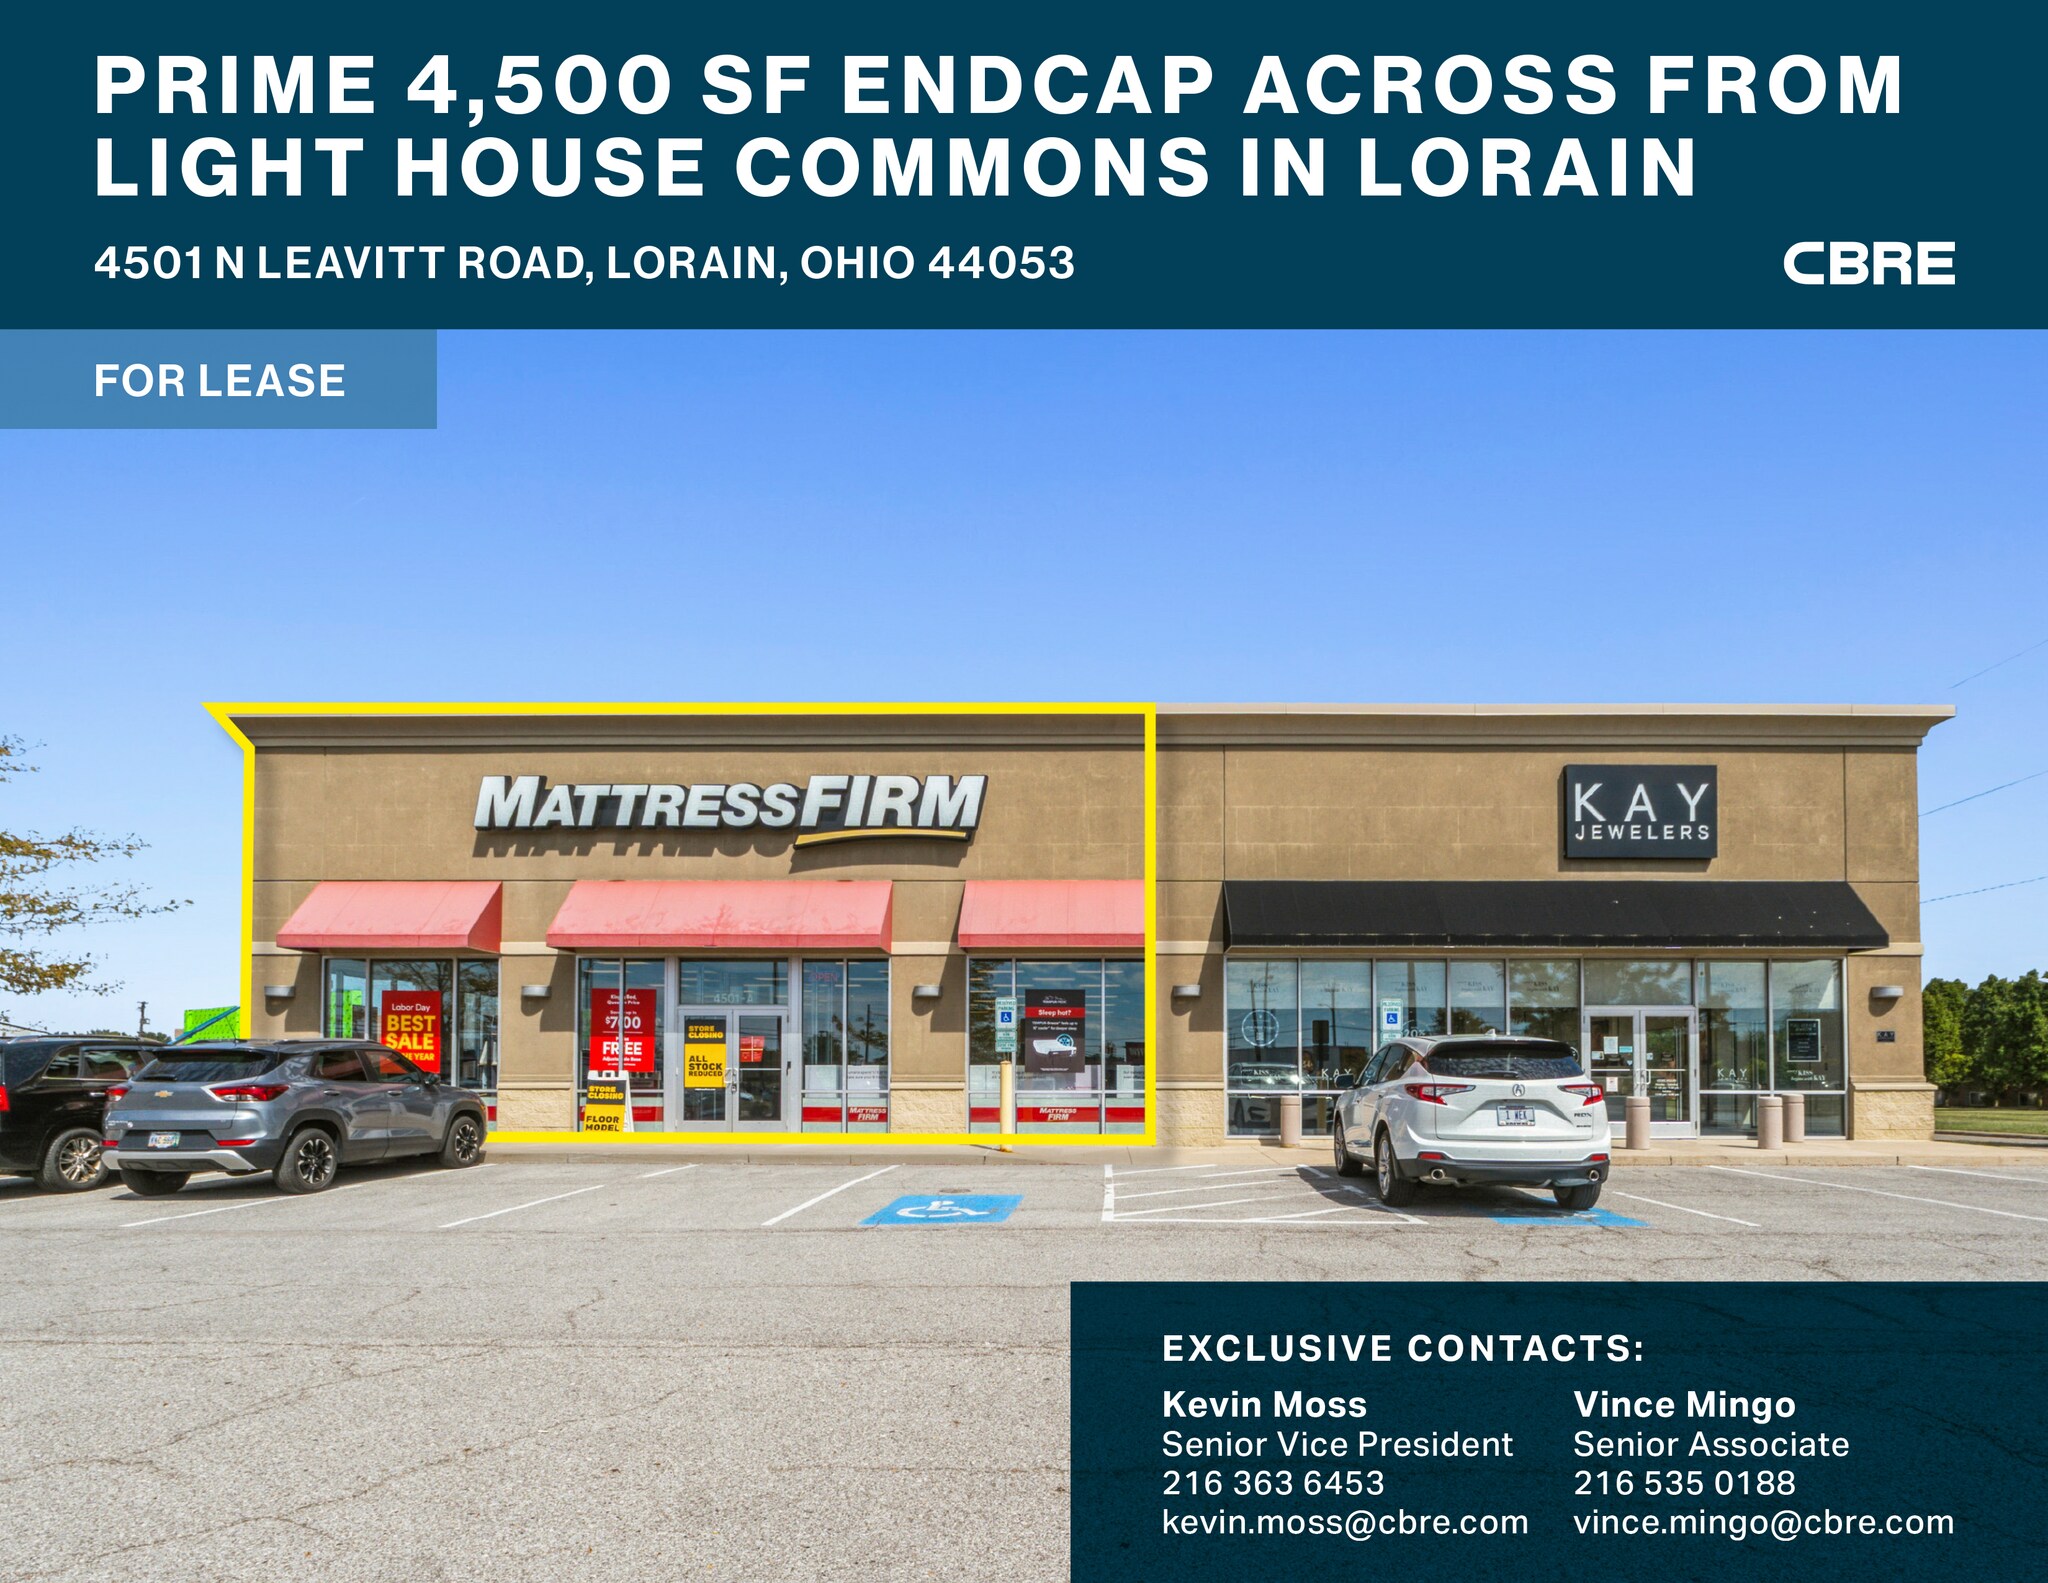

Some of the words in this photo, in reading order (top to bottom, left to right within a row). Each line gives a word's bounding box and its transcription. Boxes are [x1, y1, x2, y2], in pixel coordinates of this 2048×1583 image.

[474, 776, 800, 829] MATTRESS
[799, 774, 989, 829] FIRM
[1575, 783, 1709, 822] KAY
[1575, 824, 1710, 841] JEWELERS
[391, 1003, 414, 1011] Labor
[415, 1003, 431, 1012] Day
[1038, 1009, 1056, 1017] Sleep
[387, 1014, 436, 1032] BEST
[385, 1033, 434, 1050] SALE
[1717, 1068, 1748, 1077] KAY
[587, 1092, 624, 1100] CLOSING
[849, 1106, 887, 1114] MATTRESS
[585, 1115, 620, 1123] FLOOR
[857, 1113, 879, 1121] FIRM
